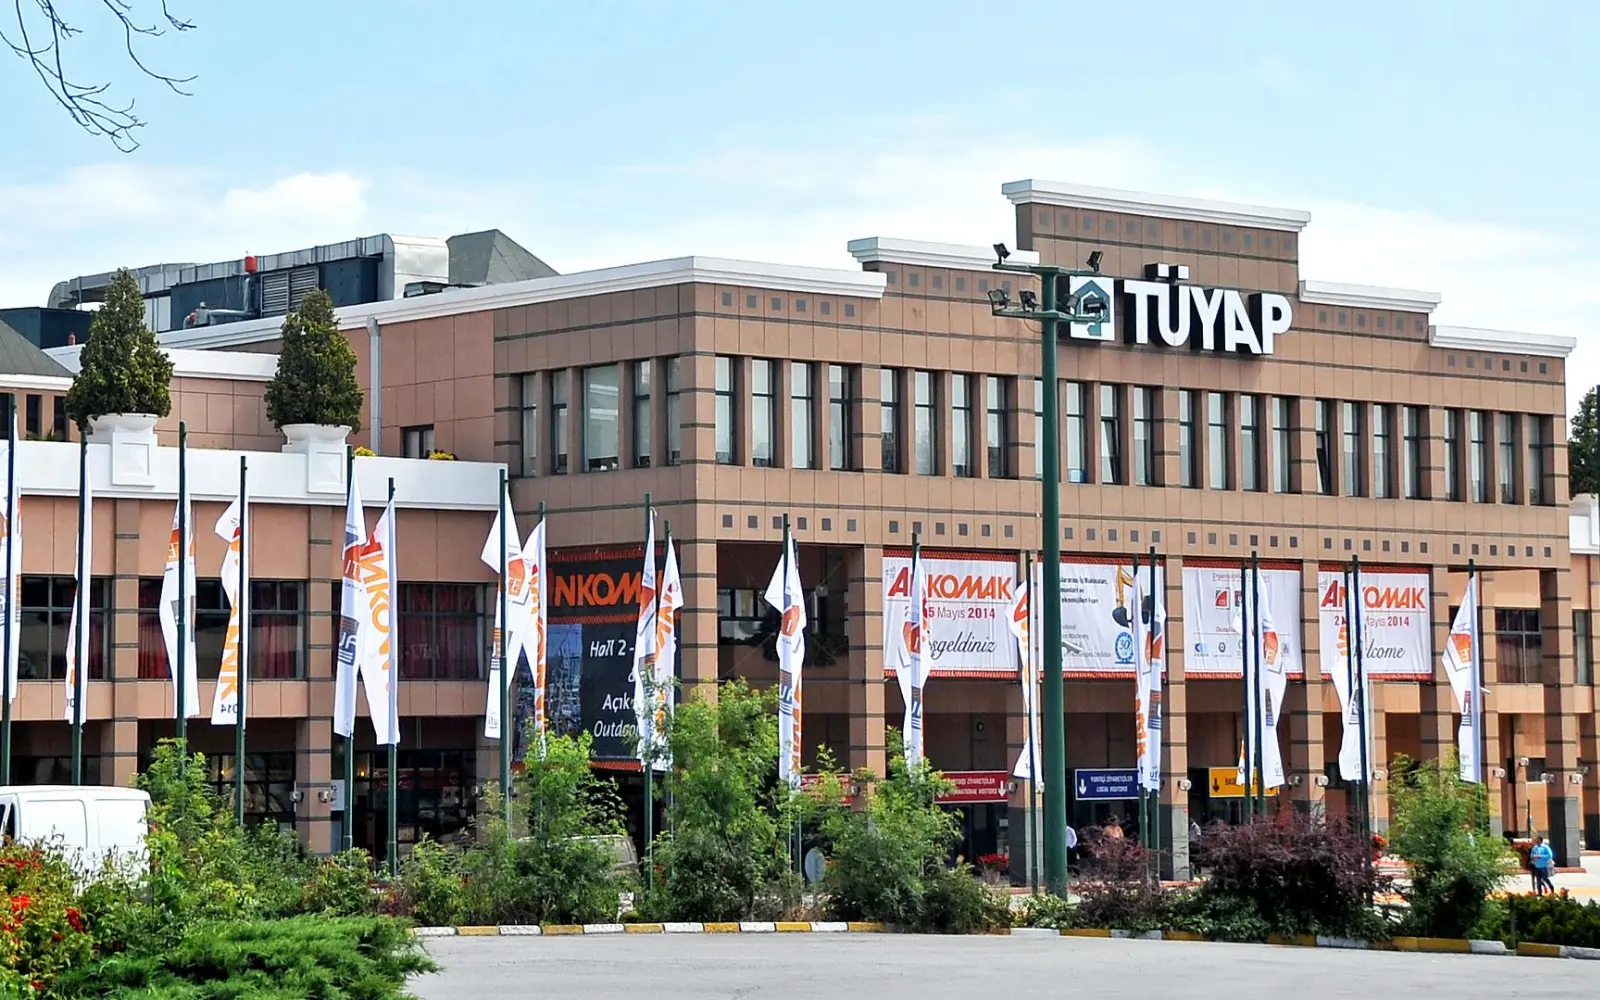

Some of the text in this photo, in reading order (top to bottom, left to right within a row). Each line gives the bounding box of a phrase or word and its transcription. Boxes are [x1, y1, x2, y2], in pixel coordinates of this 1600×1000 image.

[1123, 263, 1293, 355] TÜYAP
[888, 566, 1012, 600] AKOMAK
[967, 607, 996, 619] 2014
[1387, 616, 1410, 627] 2014
[589, 639, 615, 657] Hall
[617, 639, 627, 656] 2
[1365, 638, 1406, 659] lcome
[602, 691, 630, 713] Açık
